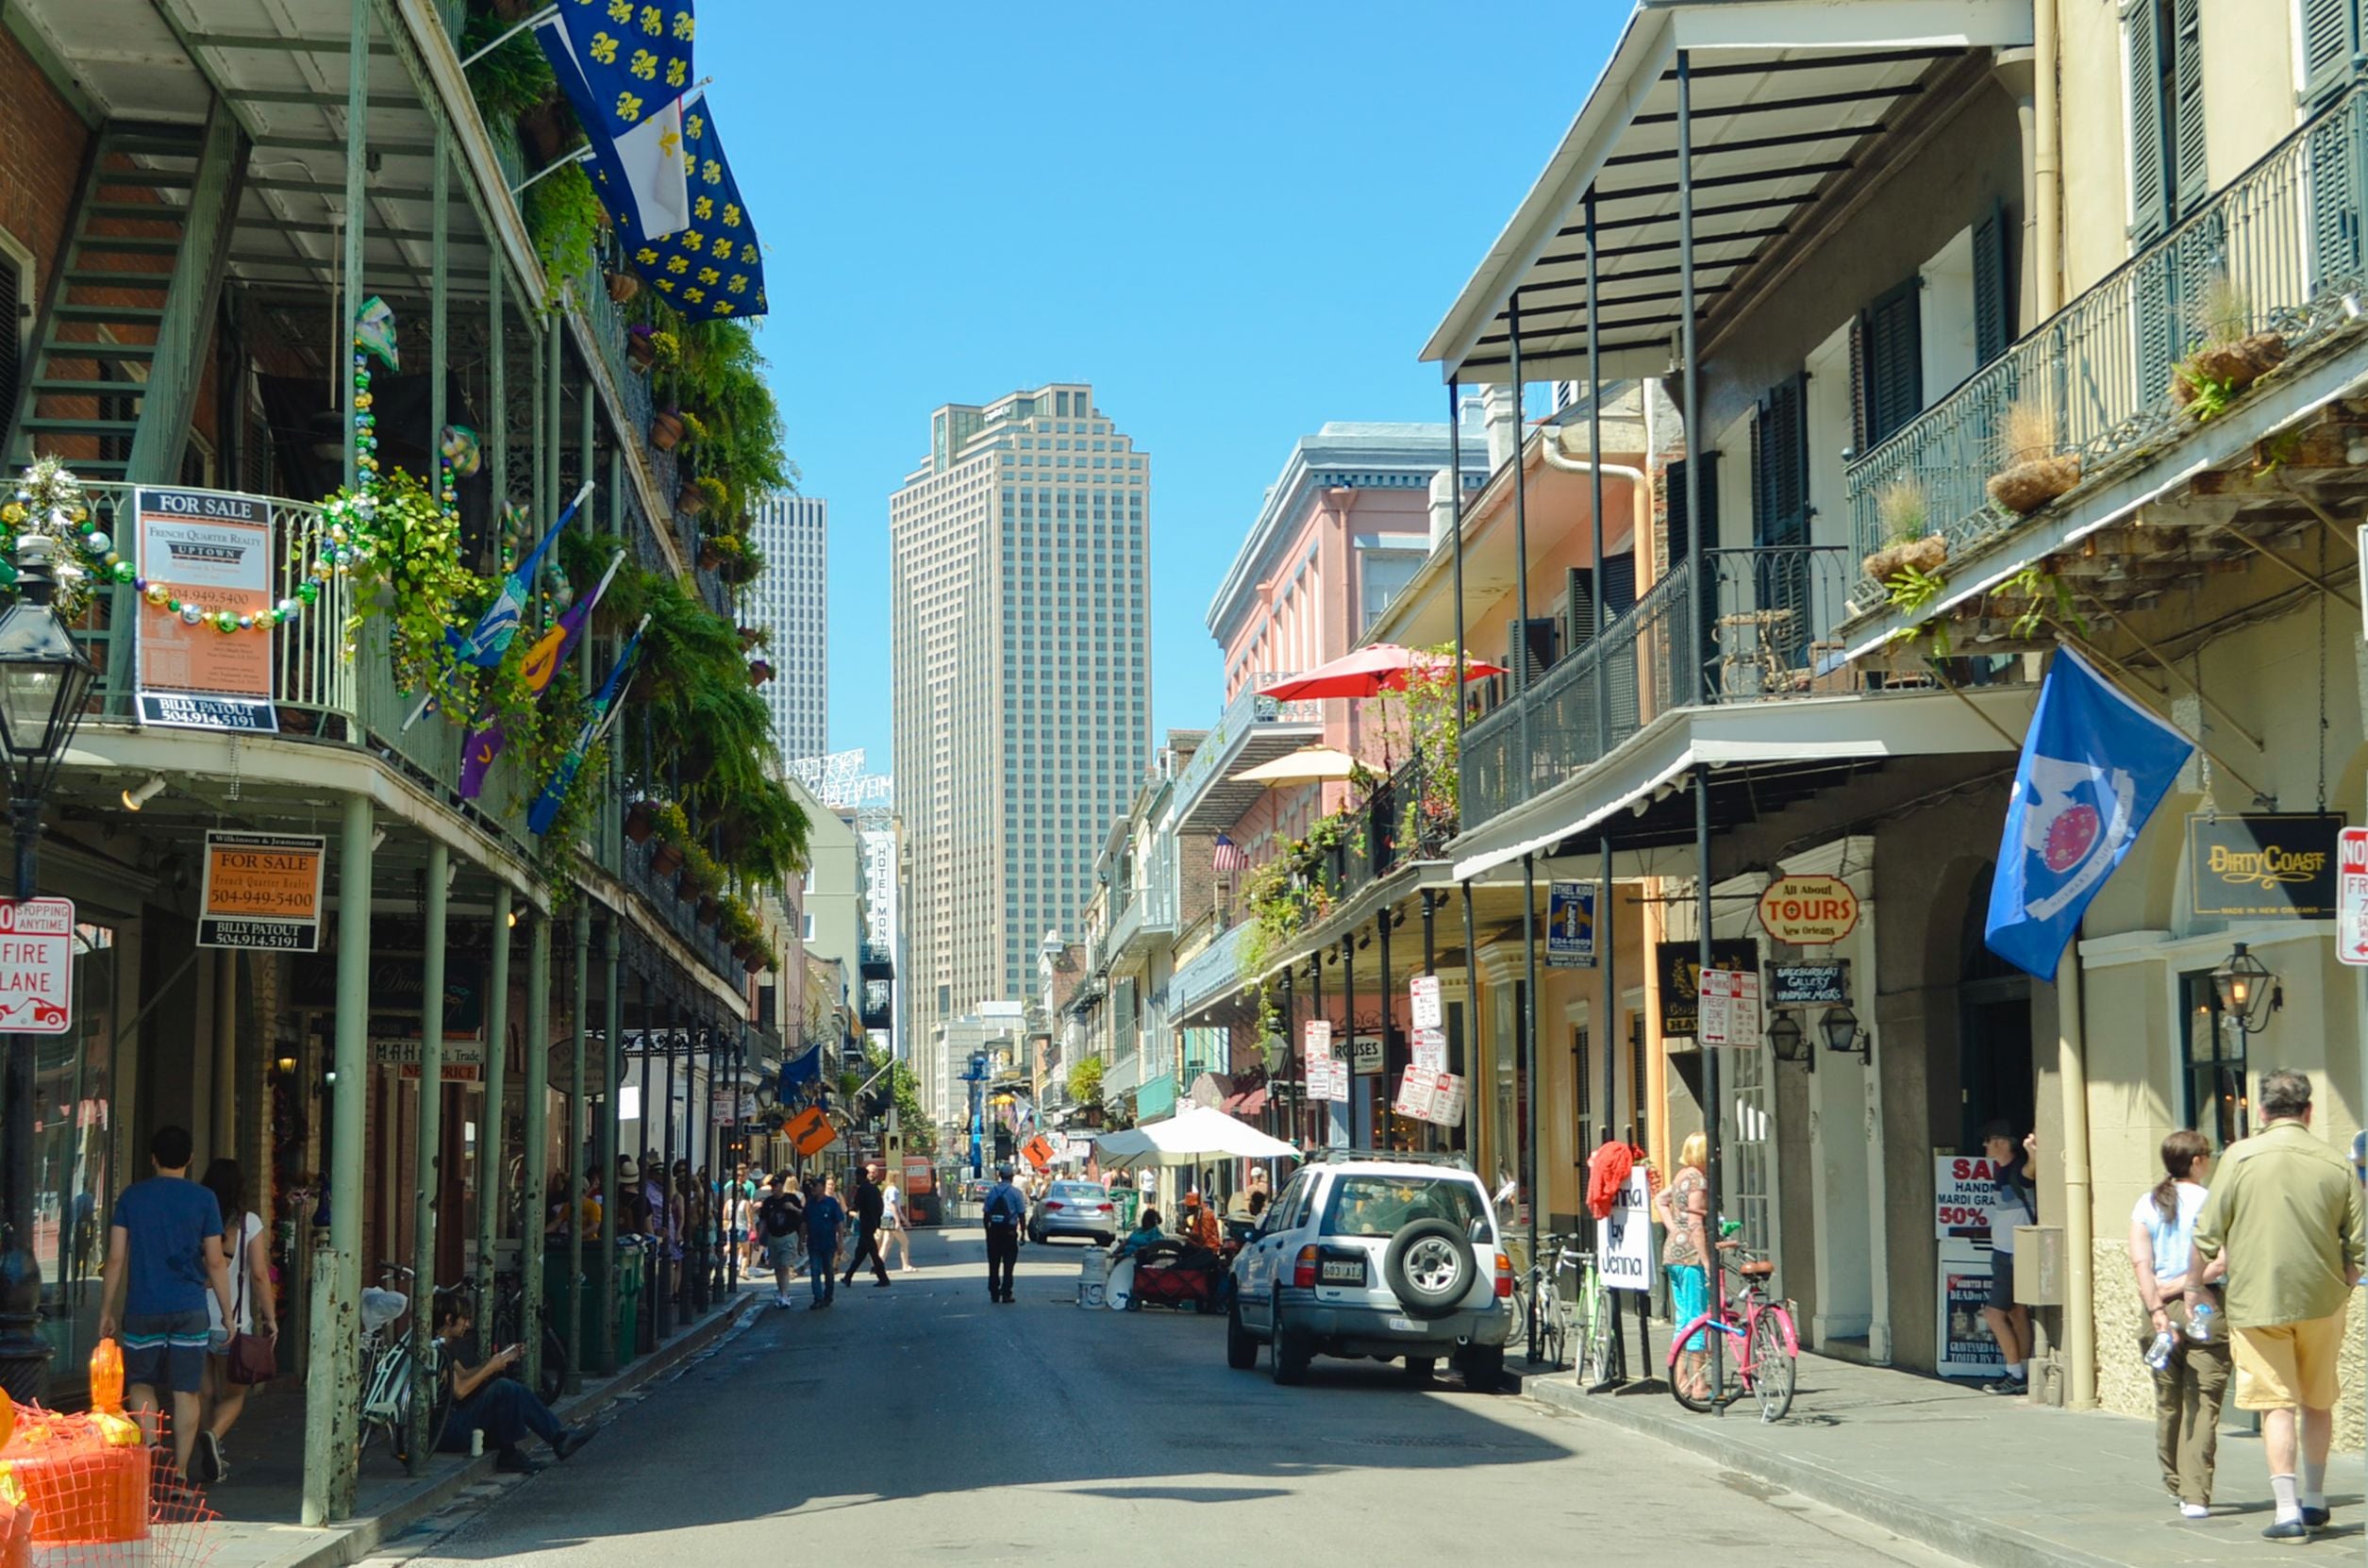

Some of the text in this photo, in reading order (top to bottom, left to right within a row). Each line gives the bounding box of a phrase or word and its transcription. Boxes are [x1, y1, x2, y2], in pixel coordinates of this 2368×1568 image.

[159, 495, 253, 518] FOR SALE
[149, 526, 261, 546] FRENCH QUARTER REALTY
[177, 545, 235, 558] UPTOWN
[158, 699, 254, 716] BILLY PATOUT
[161, 710, 257, 726] 504.914.5191
[2343, 840, 2364, 865] NO
[221, 853, 309, 871] FOR SALE
[877, 848, 887, 899] HOTEL
[210, 889, 312, 907] 504-949-5400
[1783, 885, 1832, 895] All About
[0, 903, 68, 929] O STOPPING
[1767, 899, 1851, 921] TOURS
[19, 919, 63, 930] ANYTIME
[216, 922, 301, 937] BILLY PATOUT
[1783, 926, 1835, 936] New Orleans
[215, 932, 298, 947] 504.914.5191
[3, 943, 48, 963] FIRE
[455, 1049, 479, 1061] Trade
[401, 1065, 422, 1076] NE
[1952, 1159, 1993, 1180] SA
[1938, 1193, 1995, 1206] MARDI GRA
[1939, 1207, 1988, 1226] 50%
[1611, 1214, 1624, 1243] by
[1603, 1245, 1642, 1276] Jenna
[1950, 1290, 1973, 1300] DEAD
[1949, 1353, 1976, 1363] TOUR
